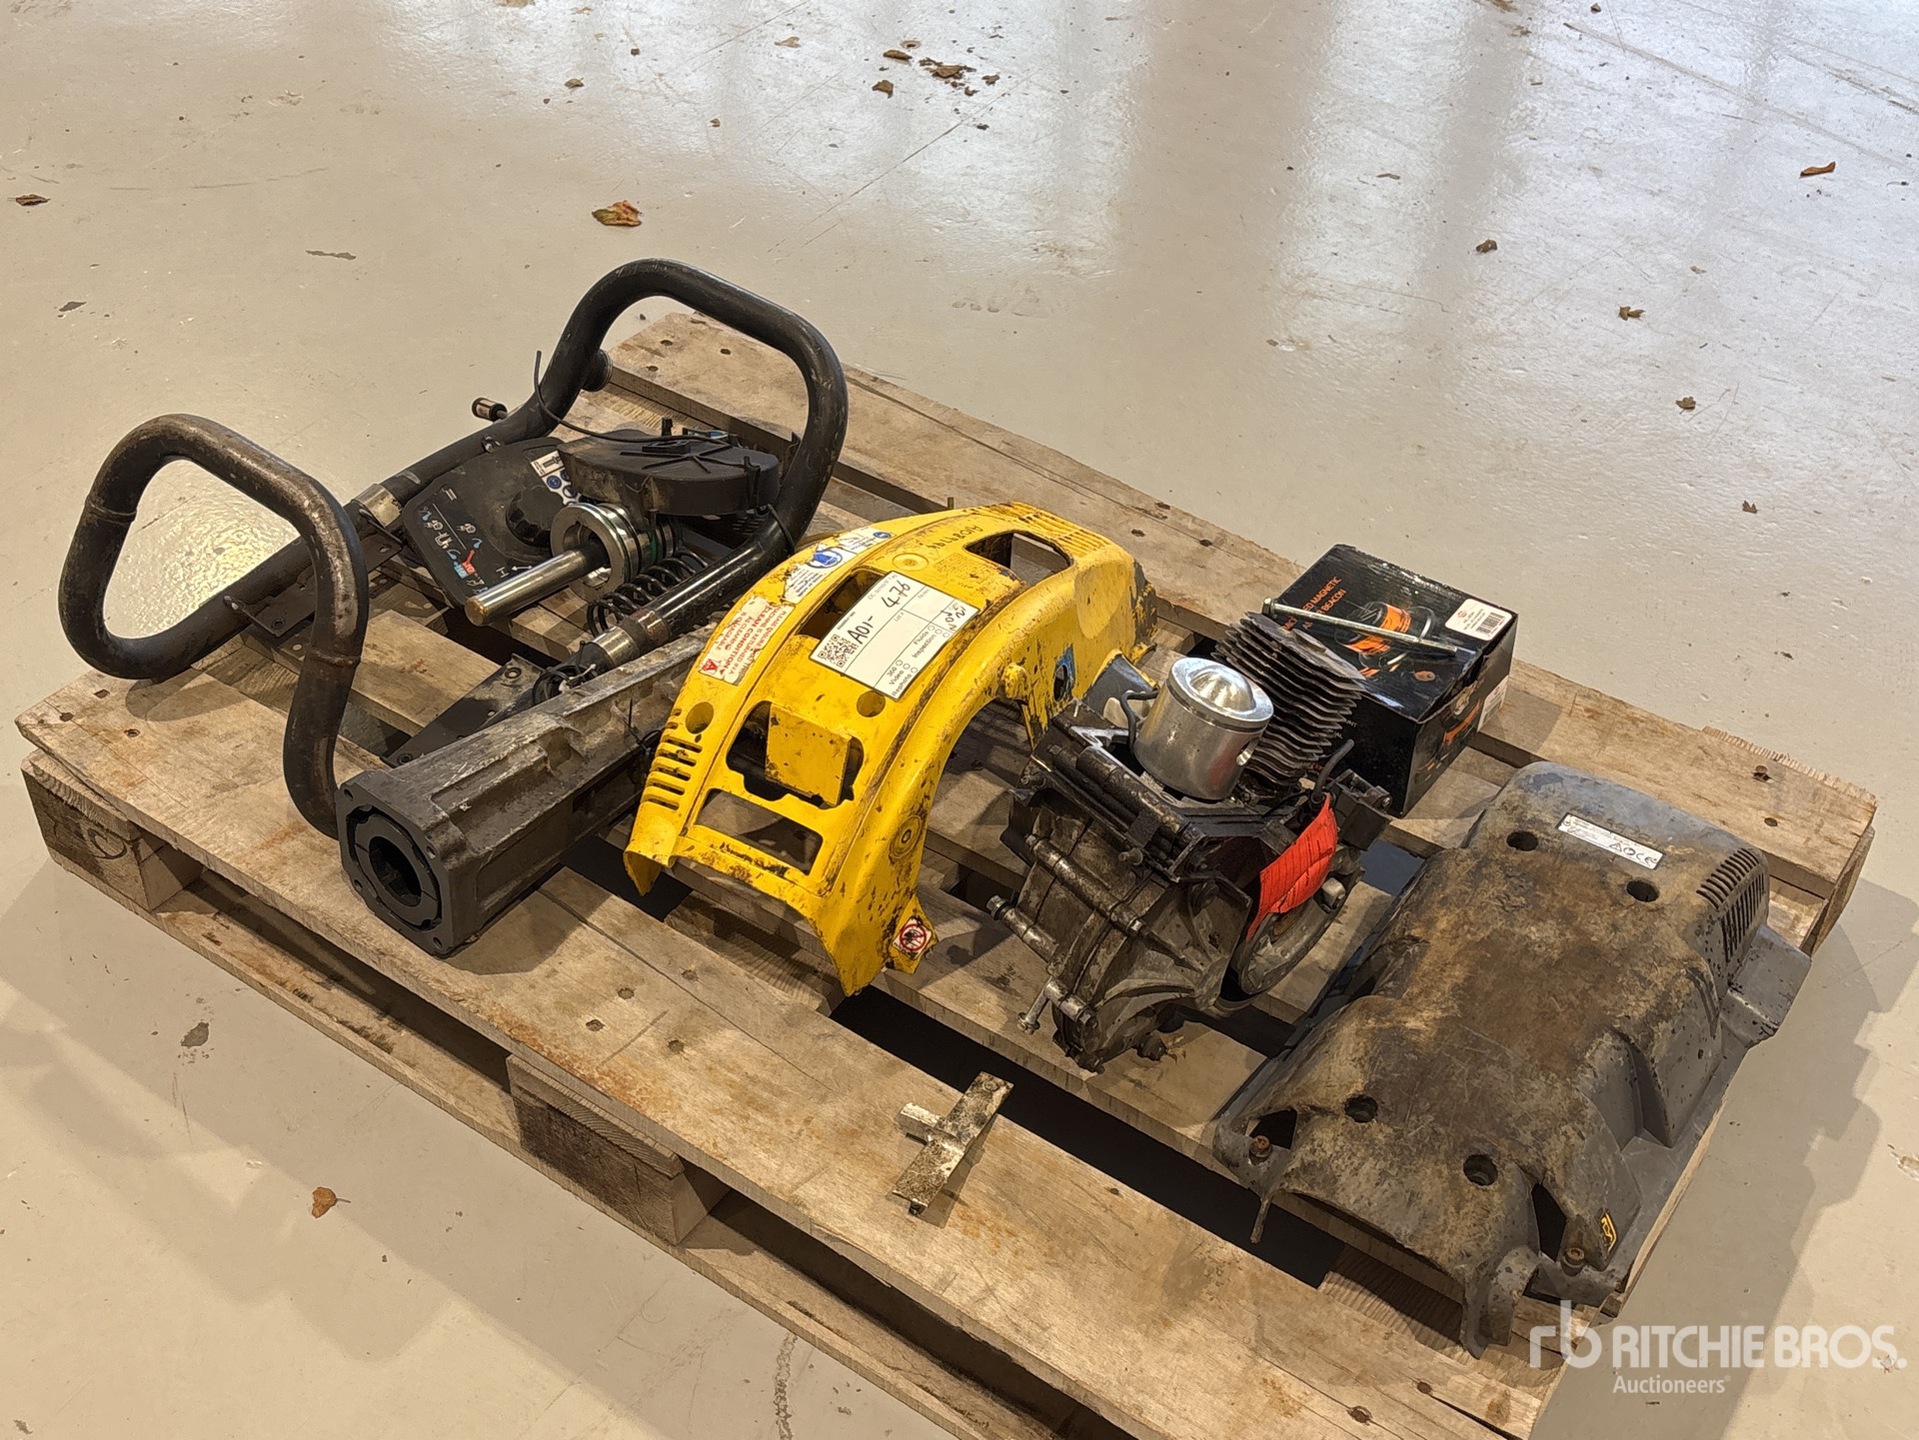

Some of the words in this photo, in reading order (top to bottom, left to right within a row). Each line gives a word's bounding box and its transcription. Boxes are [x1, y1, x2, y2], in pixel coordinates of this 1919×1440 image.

[881, 580, 911, 608] 476
[1310, 576, 1341, 604] MAGNETIC
[1320, 588, 1346, 611] BEACON
[752, 605, 773, 627] CLEAN
[771, 610, 787, 627] PLEASE
[723, 627, 754, 669] CONDITION
[737, 633, 759, 662] RETURNED
[913, 630, 929, 645] Fluids
[888, 670, 905, 685] Video
[912, 634, 936, 658] Inspection
[892, 673, 912, 697] Rephoto
